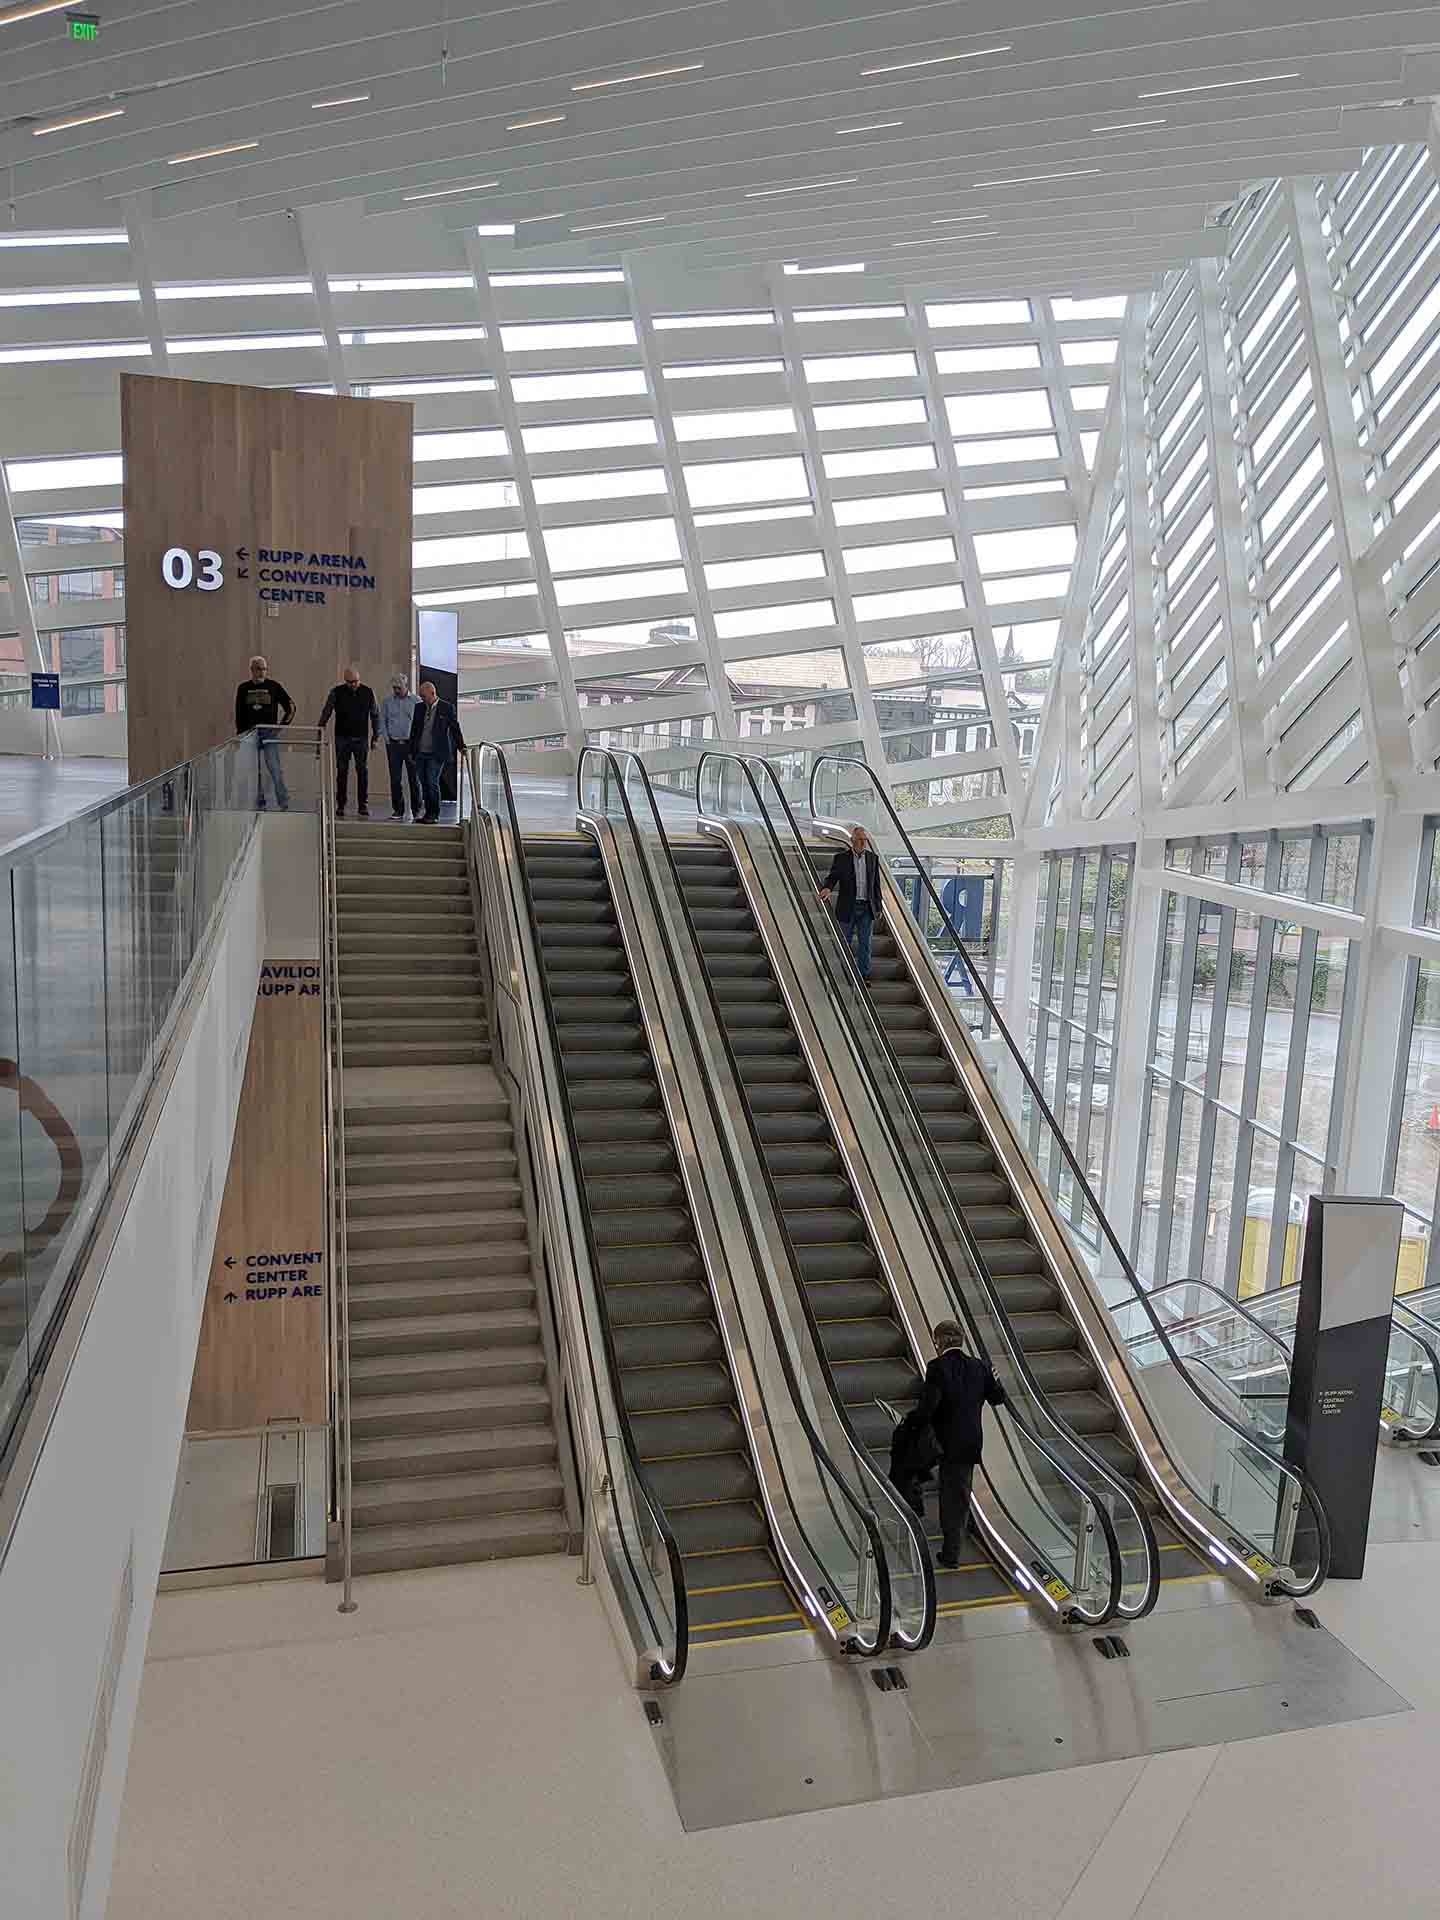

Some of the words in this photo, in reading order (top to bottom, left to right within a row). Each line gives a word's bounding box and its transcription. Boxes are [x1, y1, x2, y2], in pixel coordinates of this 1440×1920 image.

[73, 23, 97, 41] EXIT
[258, 550, 304, 565] RUPP
[308, 555, 367, 569] ARENA
[162, 547, 225, 591] 03
[258, 568, 376, 588] CONVENTION
[258, 587, 327, 605] CENTER
[245, 1269, 308, 1284] CENTER
[245, 1288, 288, 1301] RUPP
[292, 1285, 322, 1298] ARE
